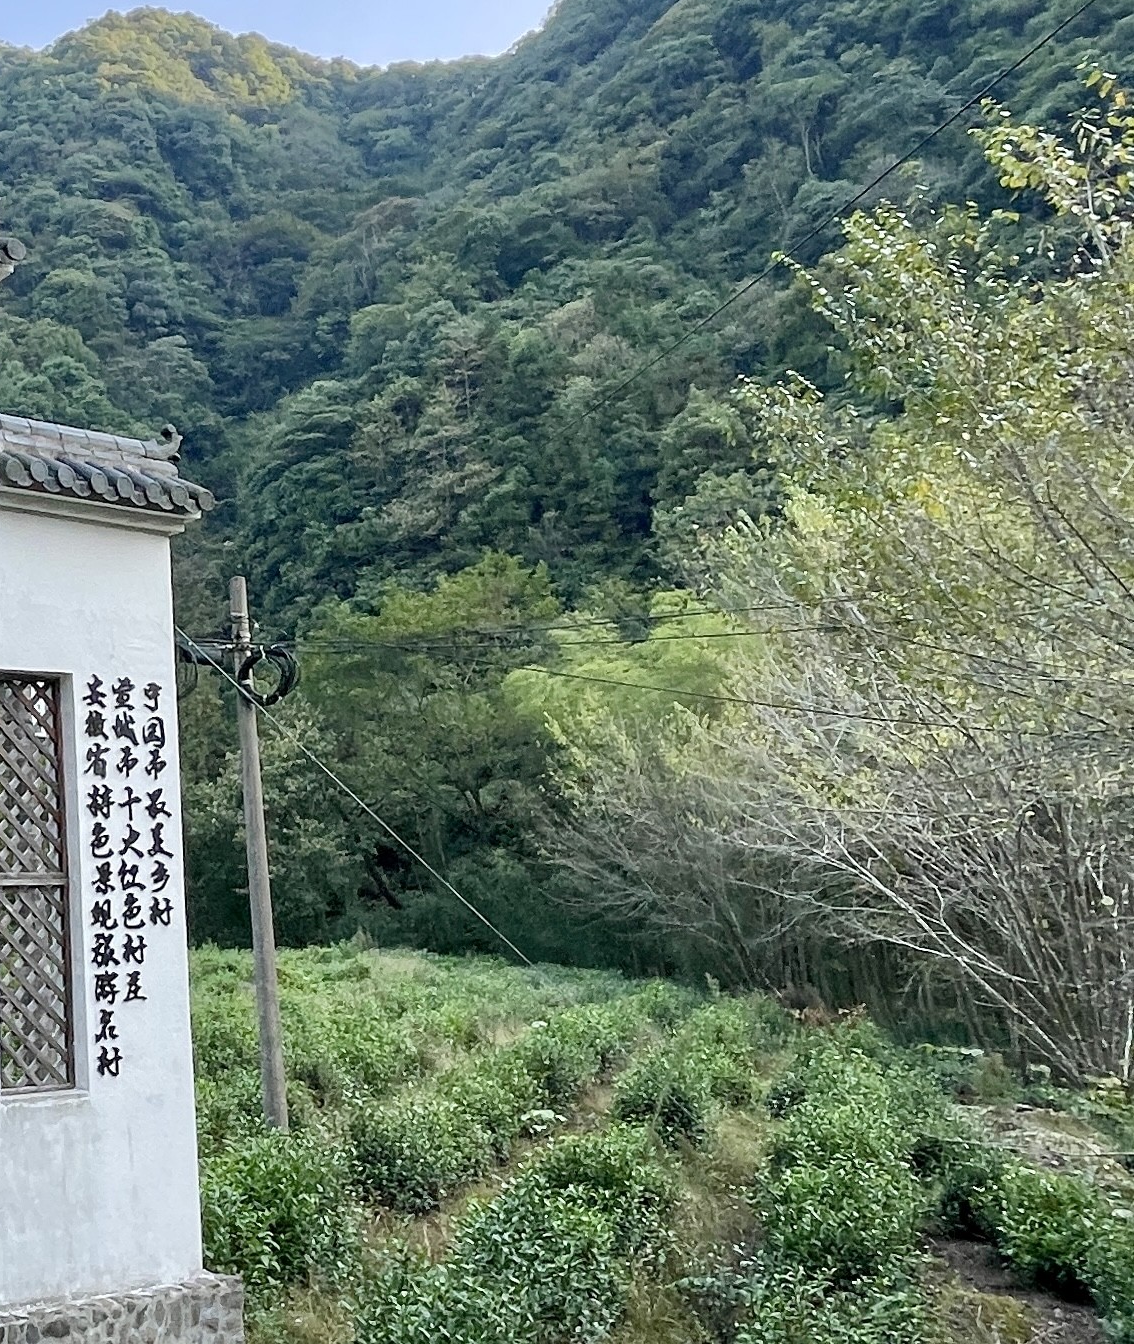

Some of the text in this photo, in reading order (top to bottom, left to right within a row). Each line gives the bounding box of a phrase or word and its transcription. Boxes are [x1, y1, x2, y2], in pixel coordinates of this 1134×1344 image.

[142, 682, 173, 927] 宁国市最美乡村
